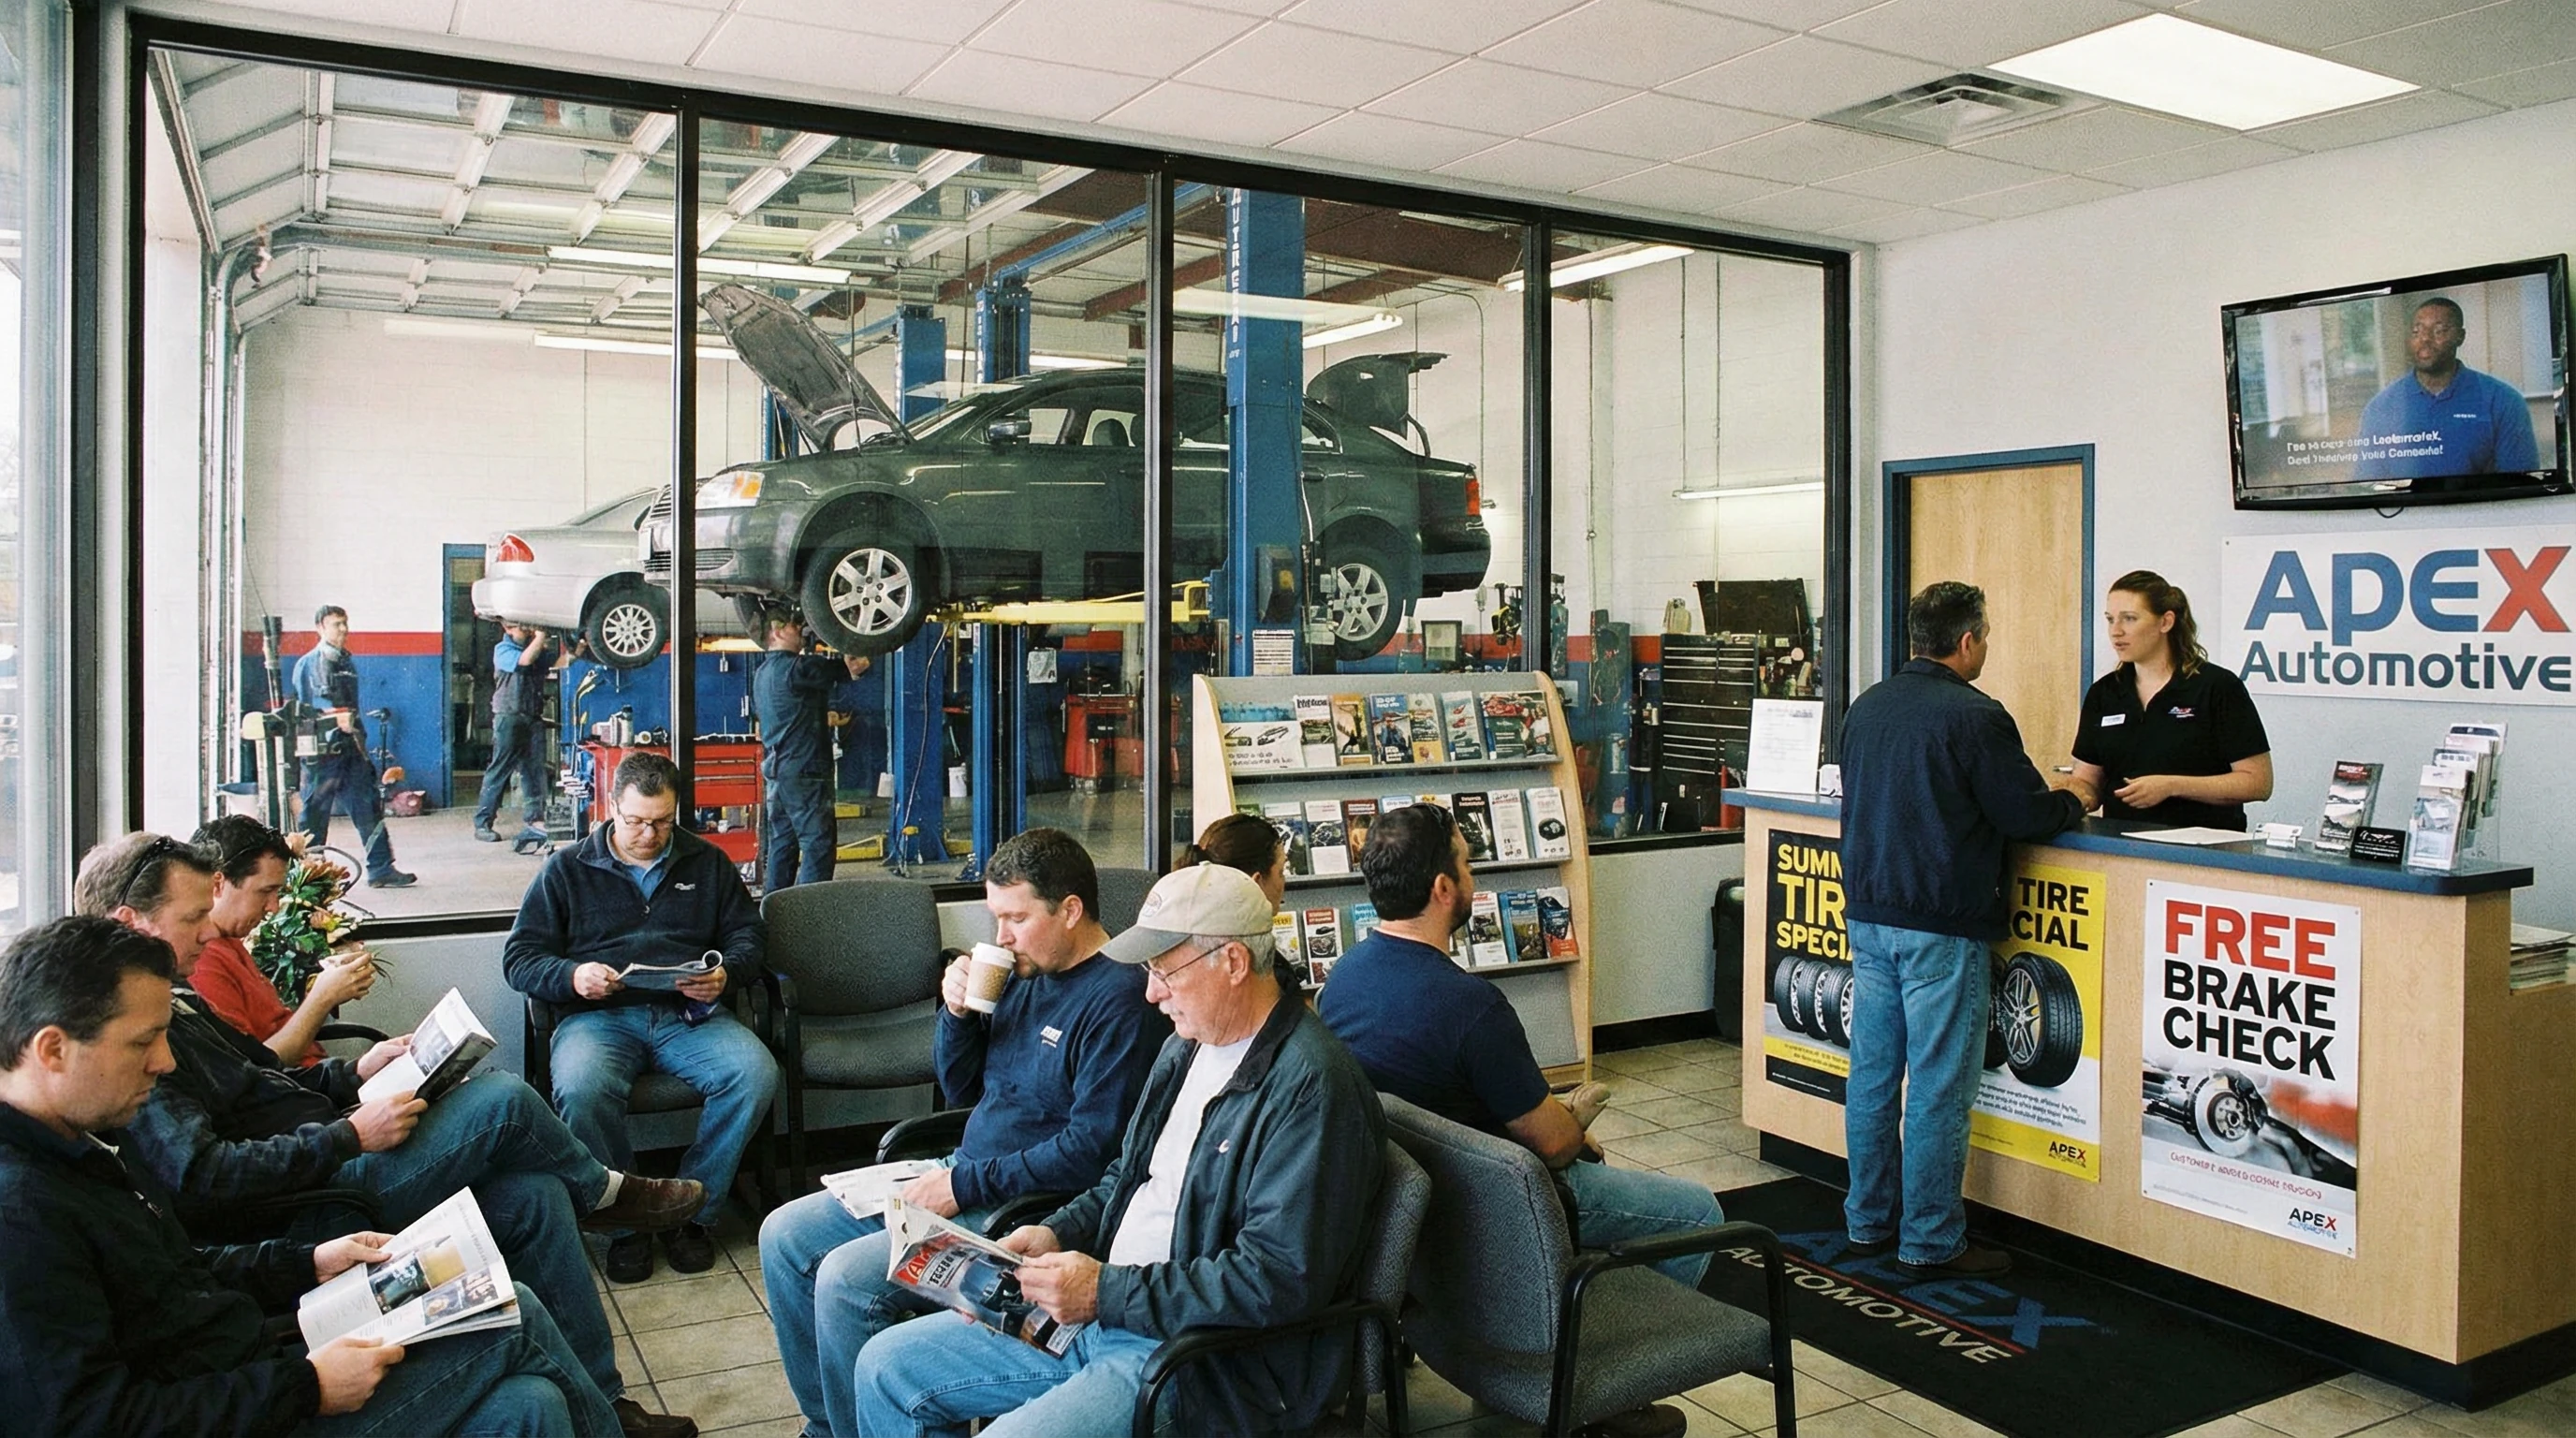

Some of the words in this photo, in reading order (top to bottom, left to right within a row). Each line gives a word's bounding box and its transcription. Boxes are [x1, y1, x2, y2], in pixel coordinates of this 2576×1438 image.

[2244, 546, 2572, 646] APEX
[2239, 640, 2572, 692] Automotive
[1777, 873, 1847, 930] TIR
[2017, 876, 2089, 917] TIRE
[1777, 921, 1852, 961] SPECI
[2012, 910, 2089, 952] CIAL
[2165, 899, 2336, 981] FREE
[2164, 959, 2336, 1031] BRAKE
[2162, 1005, 2336, 1081] CHECK
[2049, 1140, 2086, 1162] APEX
[2289, 1208, 2336, 1231] APEX
[1719, 1247, 2012, 1363] AUTOMOTIVE
